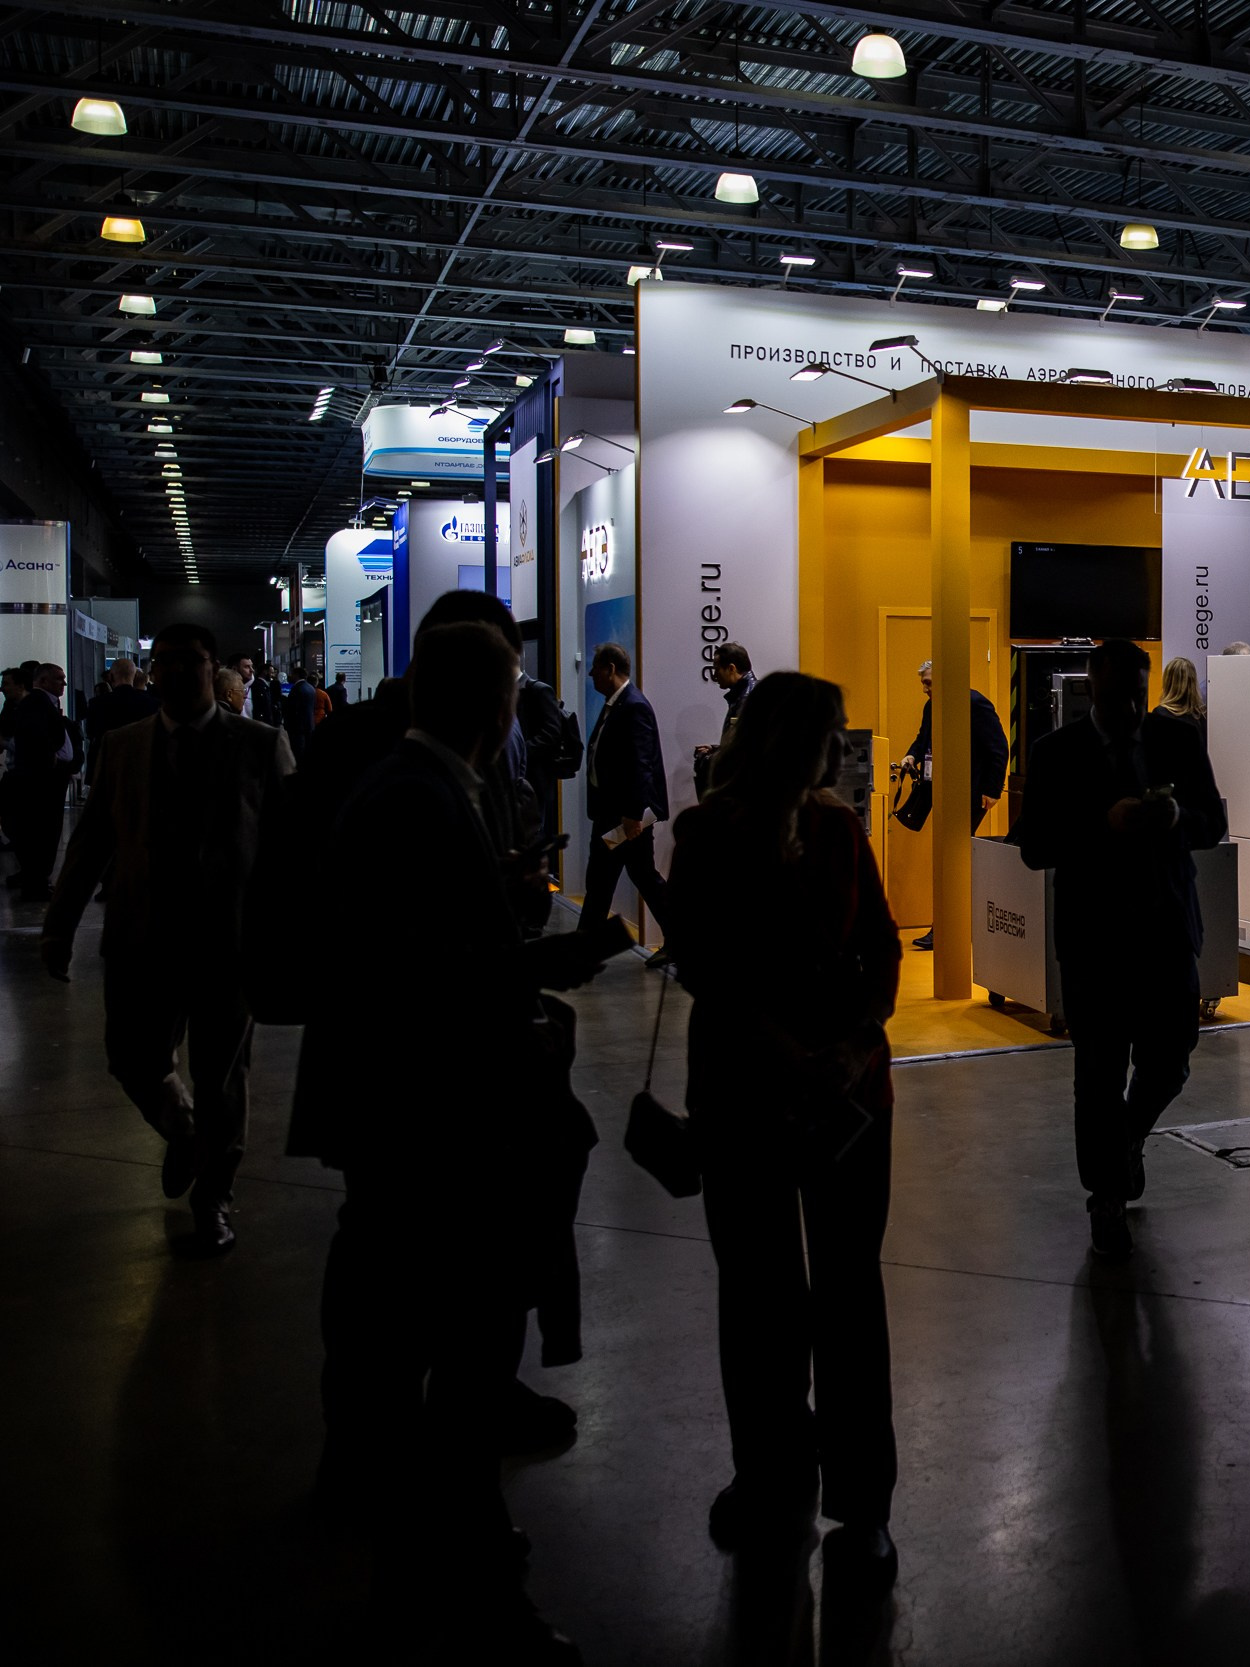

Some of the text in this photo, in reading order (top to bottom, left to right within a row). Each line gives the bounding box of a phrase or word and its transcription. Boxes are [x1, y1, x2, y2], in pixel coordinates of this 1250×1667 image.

[730, 344, 877, 369] ПРОИЗВОДСТВО
[890, 356, 901, 371] И
[438, 436, 484, 444] ОБОРУДОВ
[5, 558, 54, 571] Асана
[1195, 566, 1214, 650] aege.ru
[701, 563, 729, 683] aege.ru
[996, 907, 1025, 927] СДЕЛАНО
